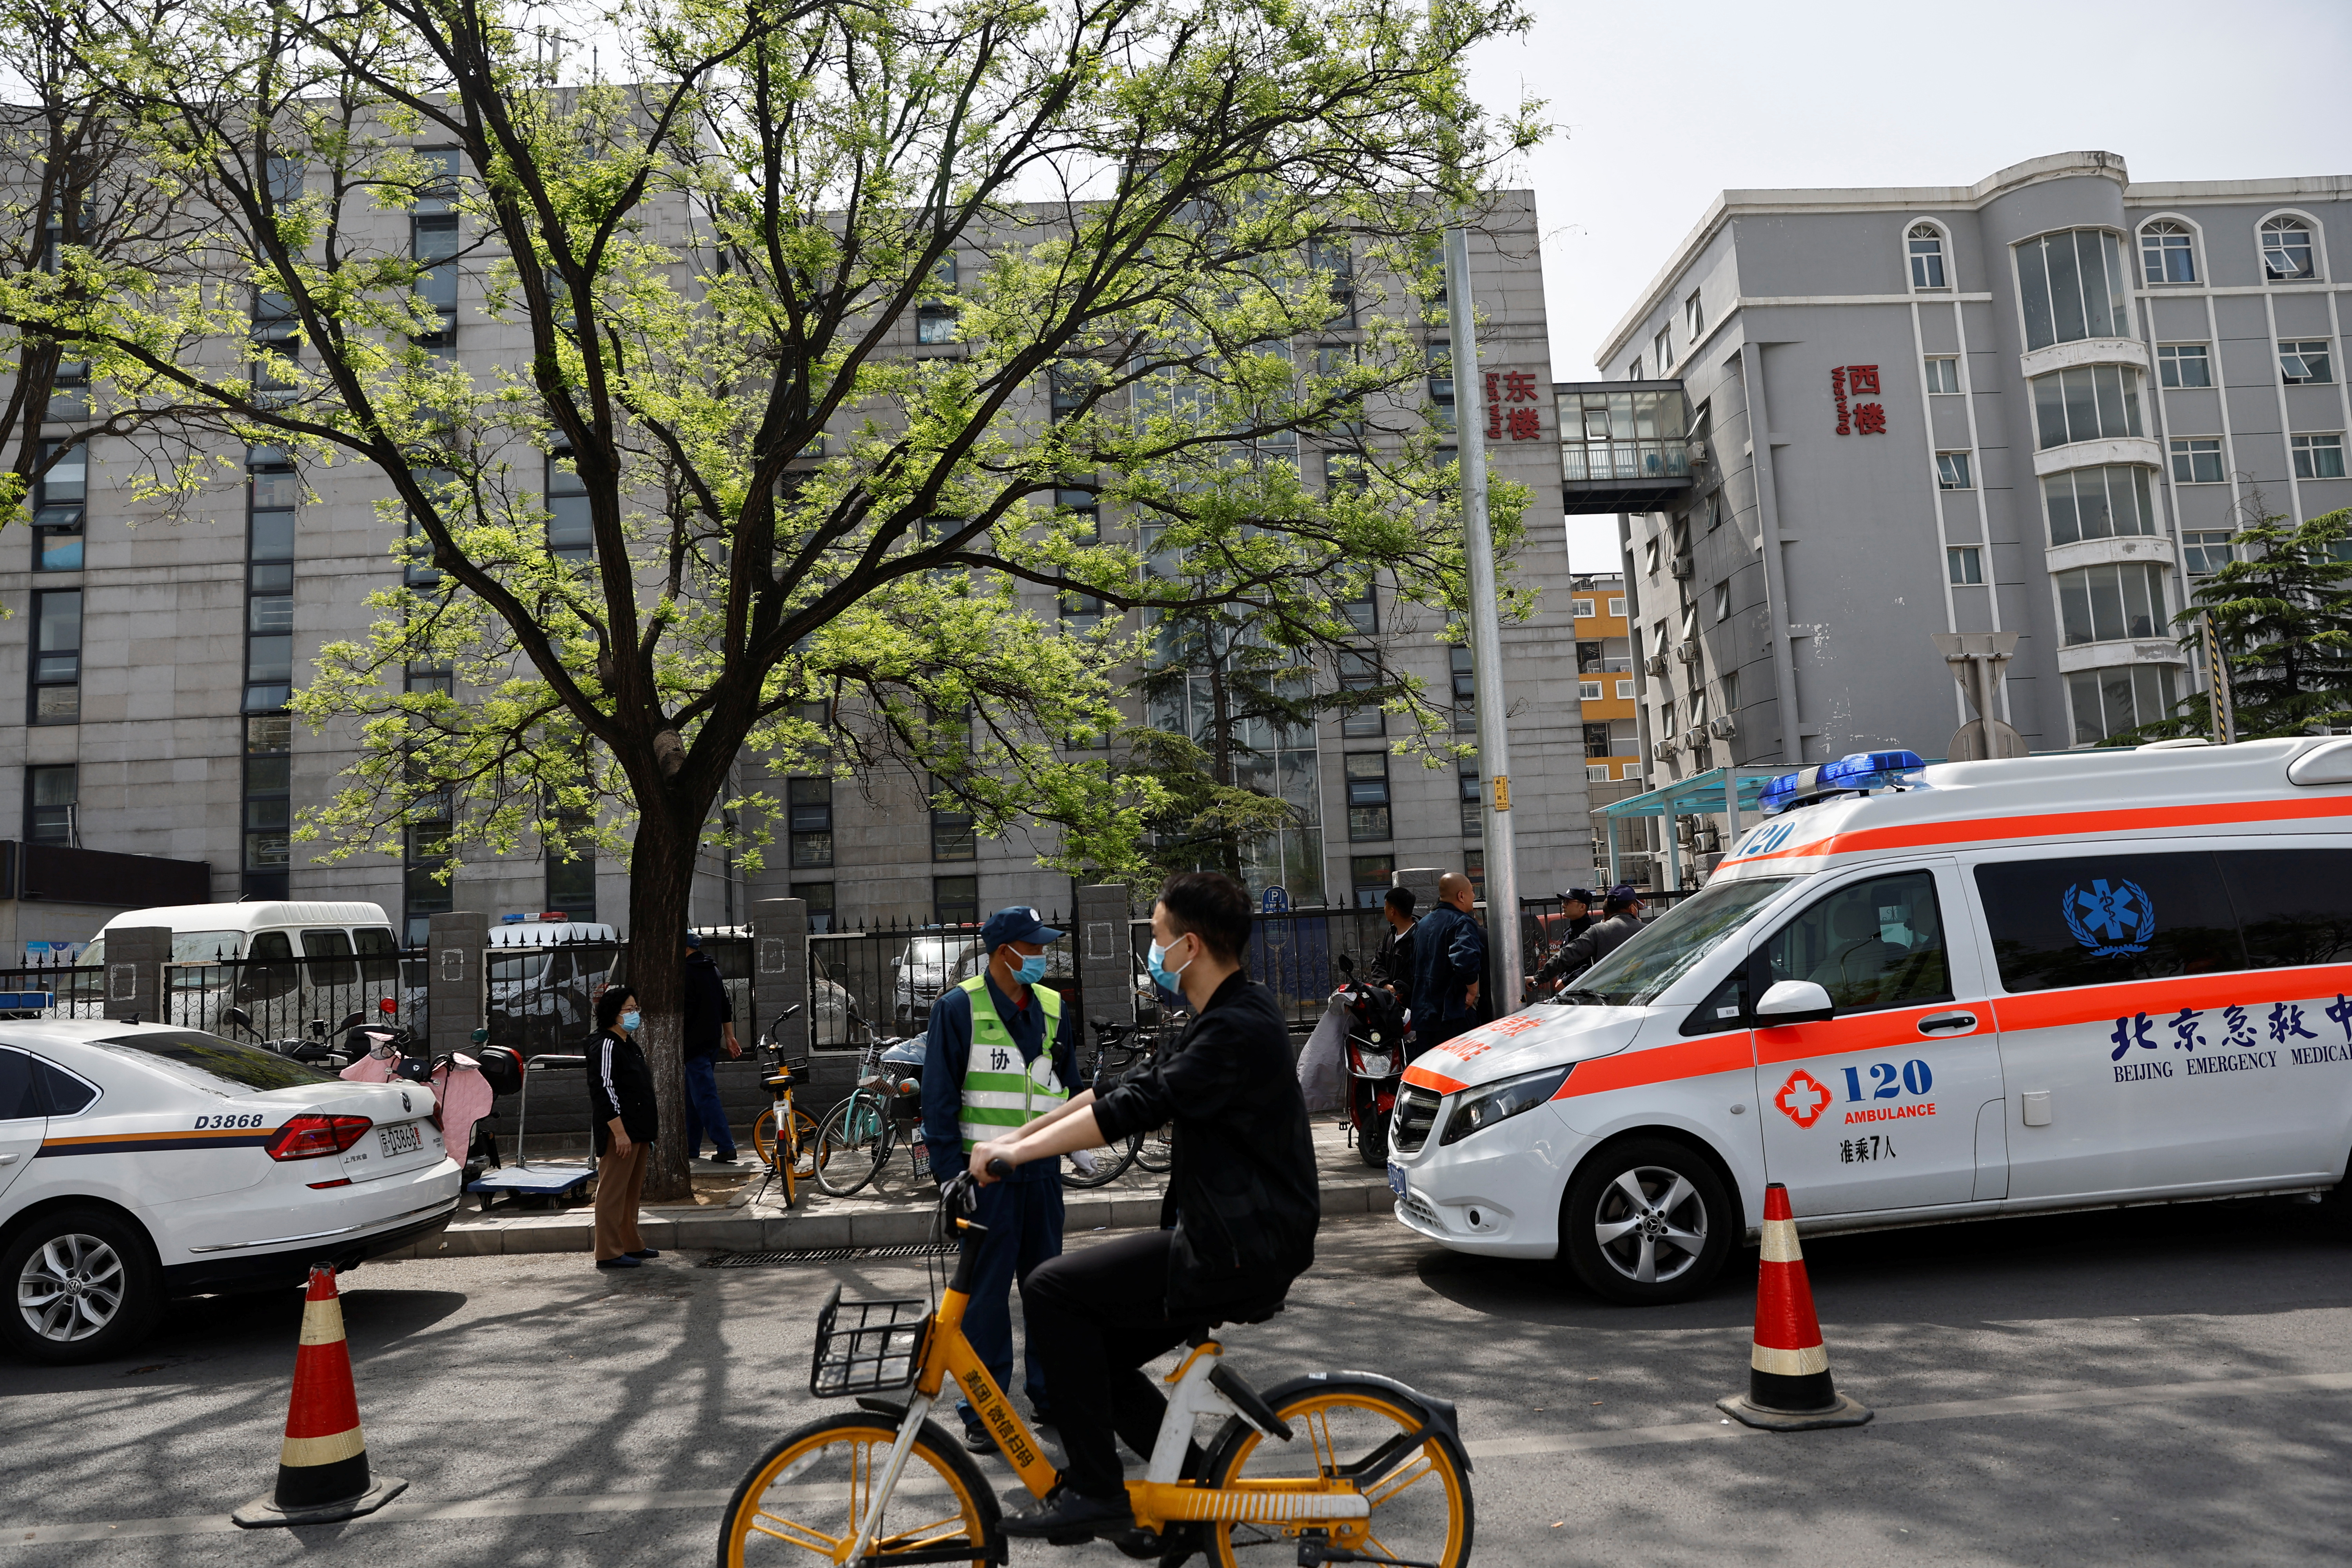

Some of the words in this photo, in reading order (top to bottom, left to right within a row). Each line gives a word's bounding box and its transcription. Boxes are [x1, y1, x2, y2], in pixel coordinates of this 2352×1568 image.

[1486, 373, 1501, 402] East
[1831, 365, 1847, 401] West
[1847, 365, 1887, 435] 西楼
[1488, 403, 1504, 439] wing
[1503, 370, 1541, 441] 东楼
[1836, 401, 1852, 435] wing
[1734, 822, 1796, 858] 120
[990, 1048, 1010, 1071] 协
[2113, 1061, 2173, 1083] BEIJING
[2186, 1051, 2277, 1076] EMERGENCY
[1840, 1059, 1933, 1103] 120
[194, 1114, 263, 1129] D3868
[1844, 1103, 1936, 1125] AMBULANCE
[1840, 1135, 1896, 1164] 准乘7人
